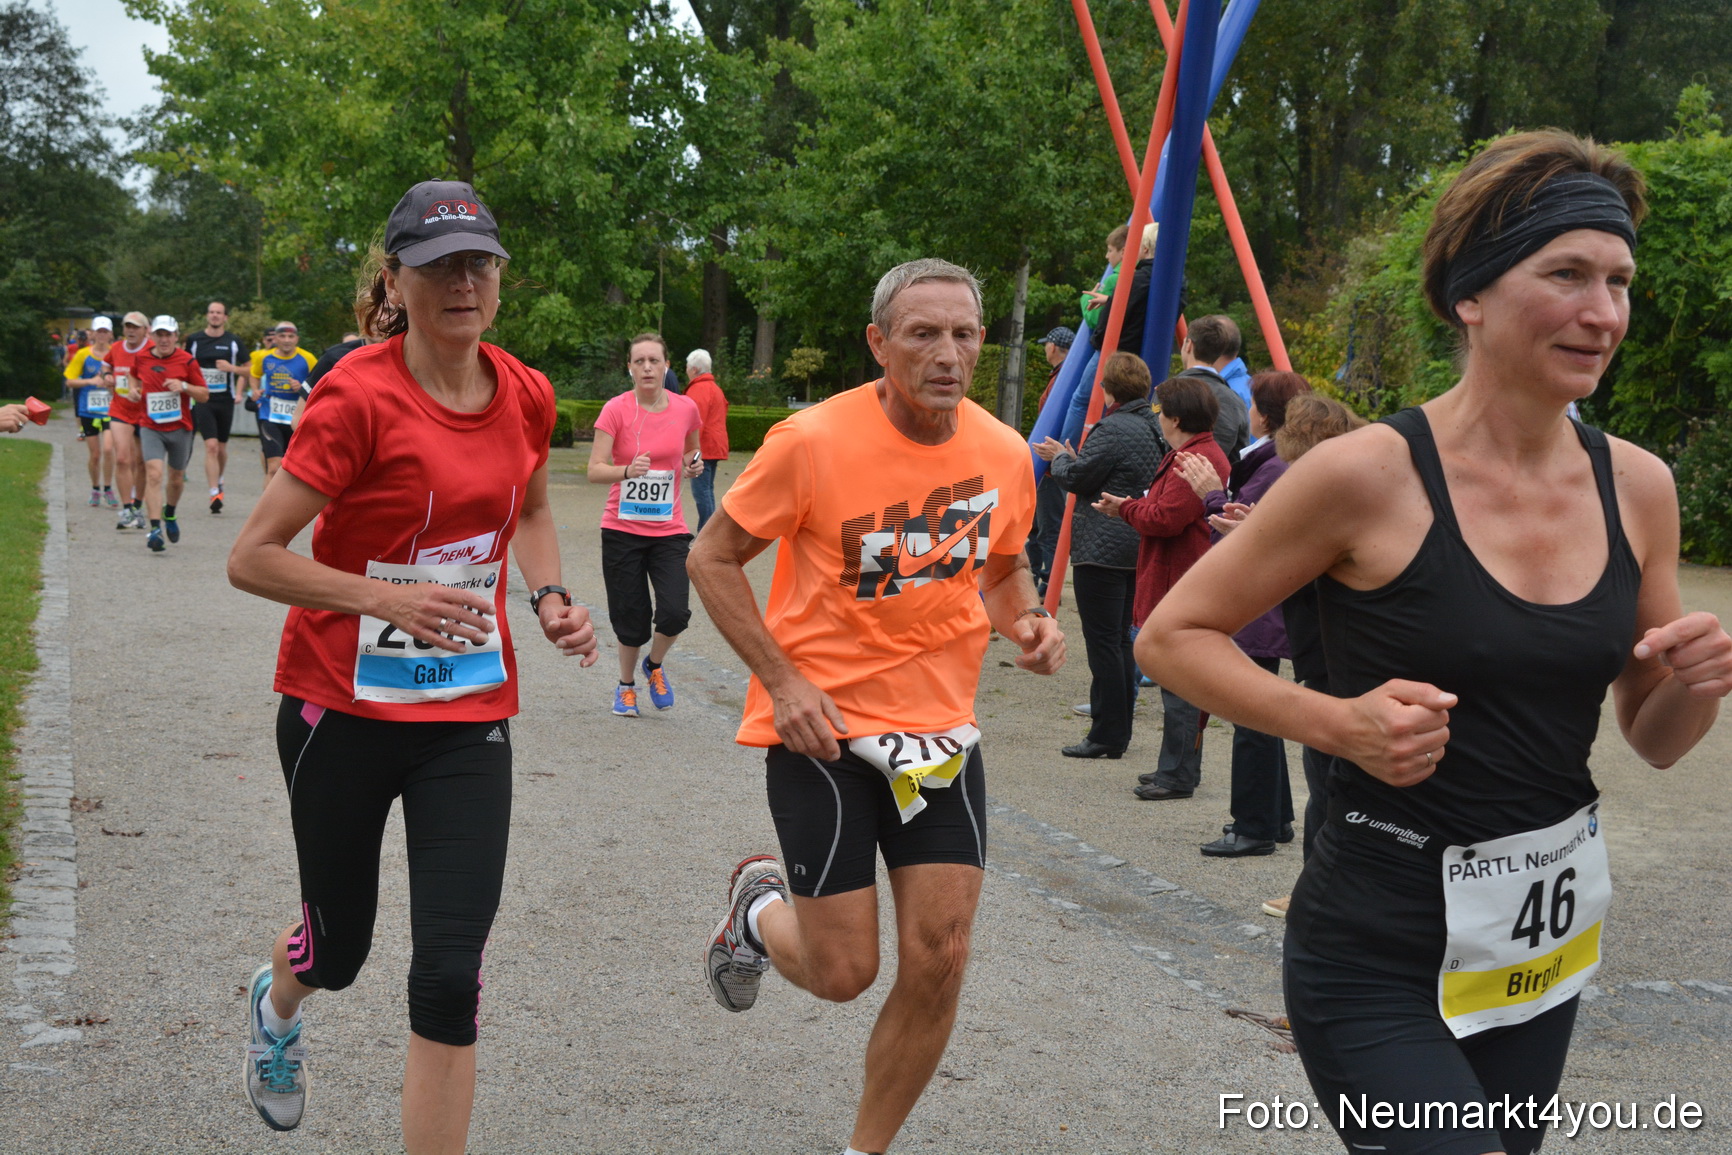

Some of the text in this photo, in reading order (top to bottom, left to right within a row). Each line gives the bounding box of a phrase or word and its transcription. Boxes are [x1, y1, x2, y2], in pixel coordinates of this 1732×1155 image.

[151, 398, 179, 412] 2288
[626, 481, 670, 502] 2897
[634, 505, 661, 514] Yvonne
[438, 546, 475, 565] DEHN
[365, 644, 371, 654] C
[414, 663, 454, 685] Gabi
[1368, 819, 1430, 843] unlimited
[1397, 836, 1424, 849] running
[1449, 827, 1587, 882] PARTL Neumarkt
[1511, 867, 1576, 949] 46
[1450, 959, 1459, 970] D
[1507, 955, 1563, 998] Birgit
